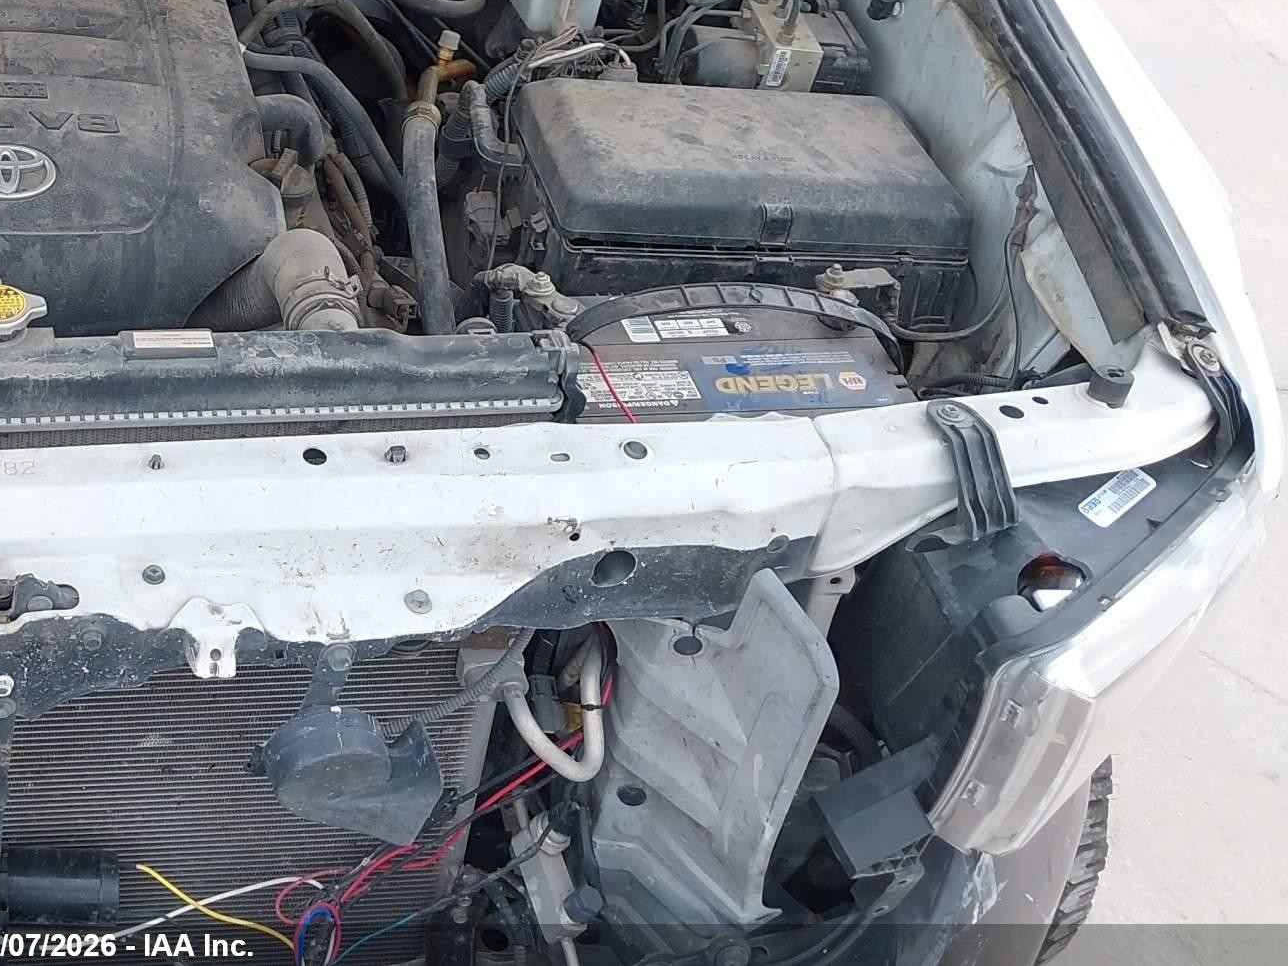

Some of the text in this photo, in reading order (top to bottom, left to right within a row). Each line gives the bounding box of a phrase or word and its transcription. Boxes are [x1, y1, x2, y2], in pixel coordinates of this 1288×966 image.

[27, 110, 121, 134] V8
[715, 372, 834, 395] LEGEND
[841, 376, 864, 387] NAPA
